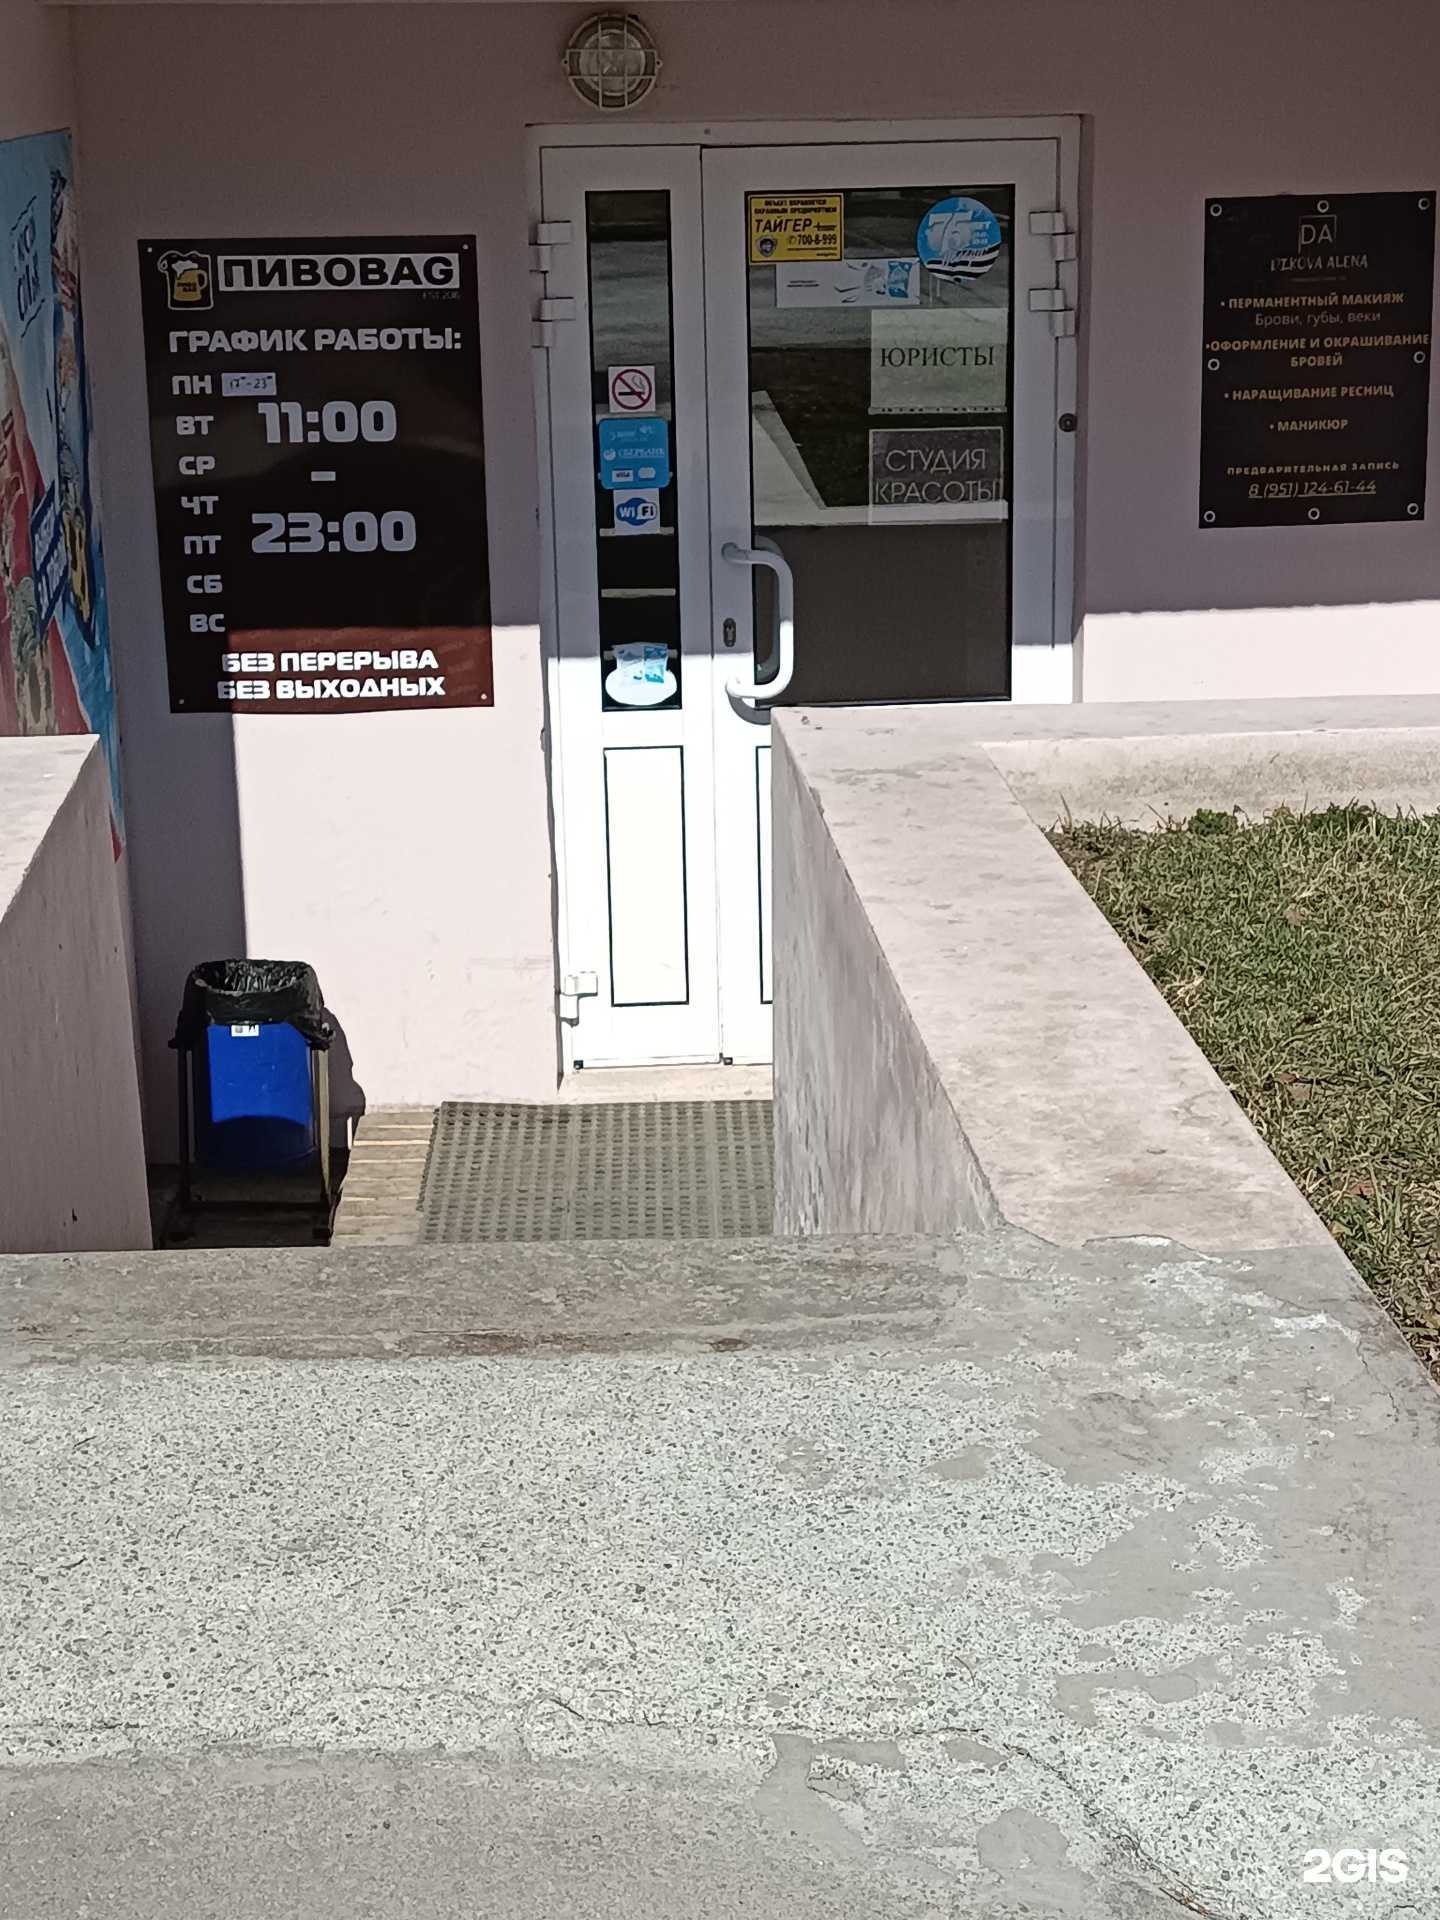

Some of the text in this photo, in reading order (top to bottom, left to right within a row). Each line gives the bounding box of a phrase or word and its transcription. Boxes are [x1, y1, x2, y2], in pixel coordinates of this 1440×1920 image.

[755, 216, 812, 232] ТАЙГЕР
[798, 234, 837, 245] 700-8-999
[1300, 223, 1333, 246] DA
[1326, 254, 1368, 269] ALENA
[1228, 292, 1404, 309] ПЕРМАНЕНТНЫЙ МАКИЯЖ
[1255, 311, 1381, 328] Брови, губы, веки
[168, 328, 462, 352] ГРАФИК РАБОТЫ:
[1210, 333, 1430, 352] ОФОРМЛЕНИЕ И ОКРАШИВАНИЕ
[881, 346, 993, 367] ЮРИСТЫ
[1290, 352, 1344, 367] БРОВЕЙ
[172, 375, 213, 395] ПН
[1232, 385, 1394, 401] НАРАЩИВАНИЕ РЕСНИЦ
[176, 416, 214, 435] ВТ
[258, 400, 397, 443] 11:00
[1277, 418, 1349, 431] МАНИКЮР
[178, 456, 216, 475] СР
[886, 447, 986, 475] СТУДИЯ
[1227, 462, 1400, 475] ПРЕДВАРИТЕЛЬНАЯ ЗАПИСЬ
[875, 480, 997, 504] КРАСОТЫ
[1248, 480, 1376, 498] 8 (951) 124-61-44
[181, 496, 219, 515] ЧТ
[251, 510, 417, 553] 23:00
[184, 536, 222, 554] ПТ
[187, 575, 223, 594] СБ
[190, 614, 226, 633] ВС
[222, 650, 438, 673] БЕЗ ПЕРЕРЫВА
[217, 676, 446, 699] БЕЗ ВЫХОДНЫХ
